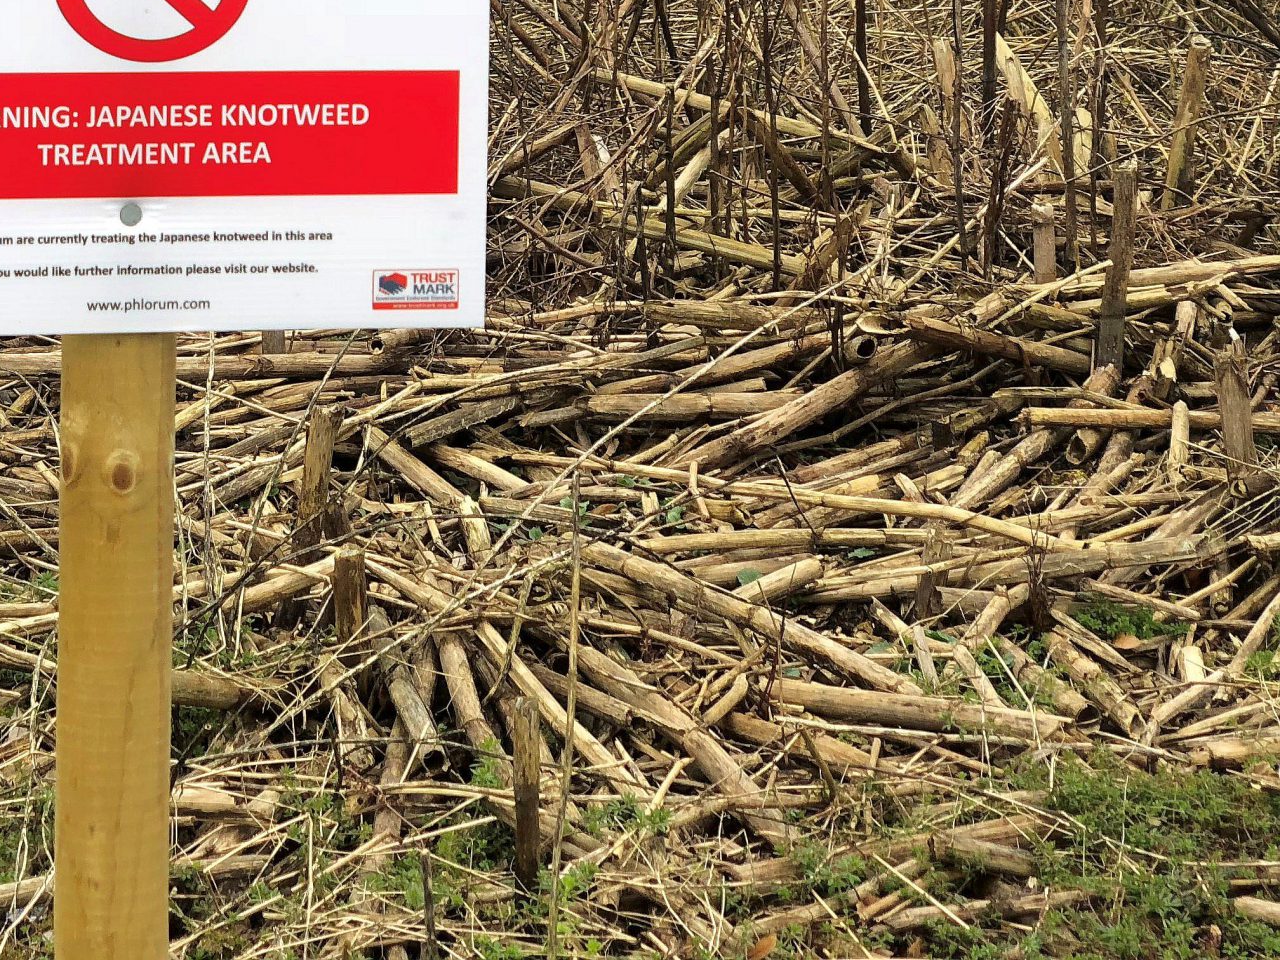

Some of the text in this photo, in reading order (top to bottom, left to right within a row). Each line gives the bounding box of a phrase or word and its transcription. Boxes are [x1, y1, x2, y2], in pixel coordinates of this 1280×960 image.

[86, 104, 213, 129] JAPANESE
[221, 103, 370, 127] KNOTWEED
[37, 141, 272, 166] TREATMENT AREA
[16, 236, 35, 245] are
[37, 233, 89, 246] currently
[91, 233, 137, 246] treating
[138, 232, 157, 243] the
[159, 232, 211, 245] Japanese
[213, 231, 269, 243] knotweed
[271, 231, 282, 241] in
[285, 230, 306, 241] this
[308, 232, 333, 241] area
[13, 266, 49, 278] would
[51, 266, 72, 277] like
[74, 265, 114, 277] further
[116, 264, 183, 276] information
[185, 263, 222, 277] please
[224, 263, 247, 274] visit
[249, 265, 269, 274] our
[271, 262, 318, 274] website.
[411, 272, 456, 284] TRUST
[413, 283, 455, 295] MARK
[86, 298, 210, 313] www.phlorum.com
